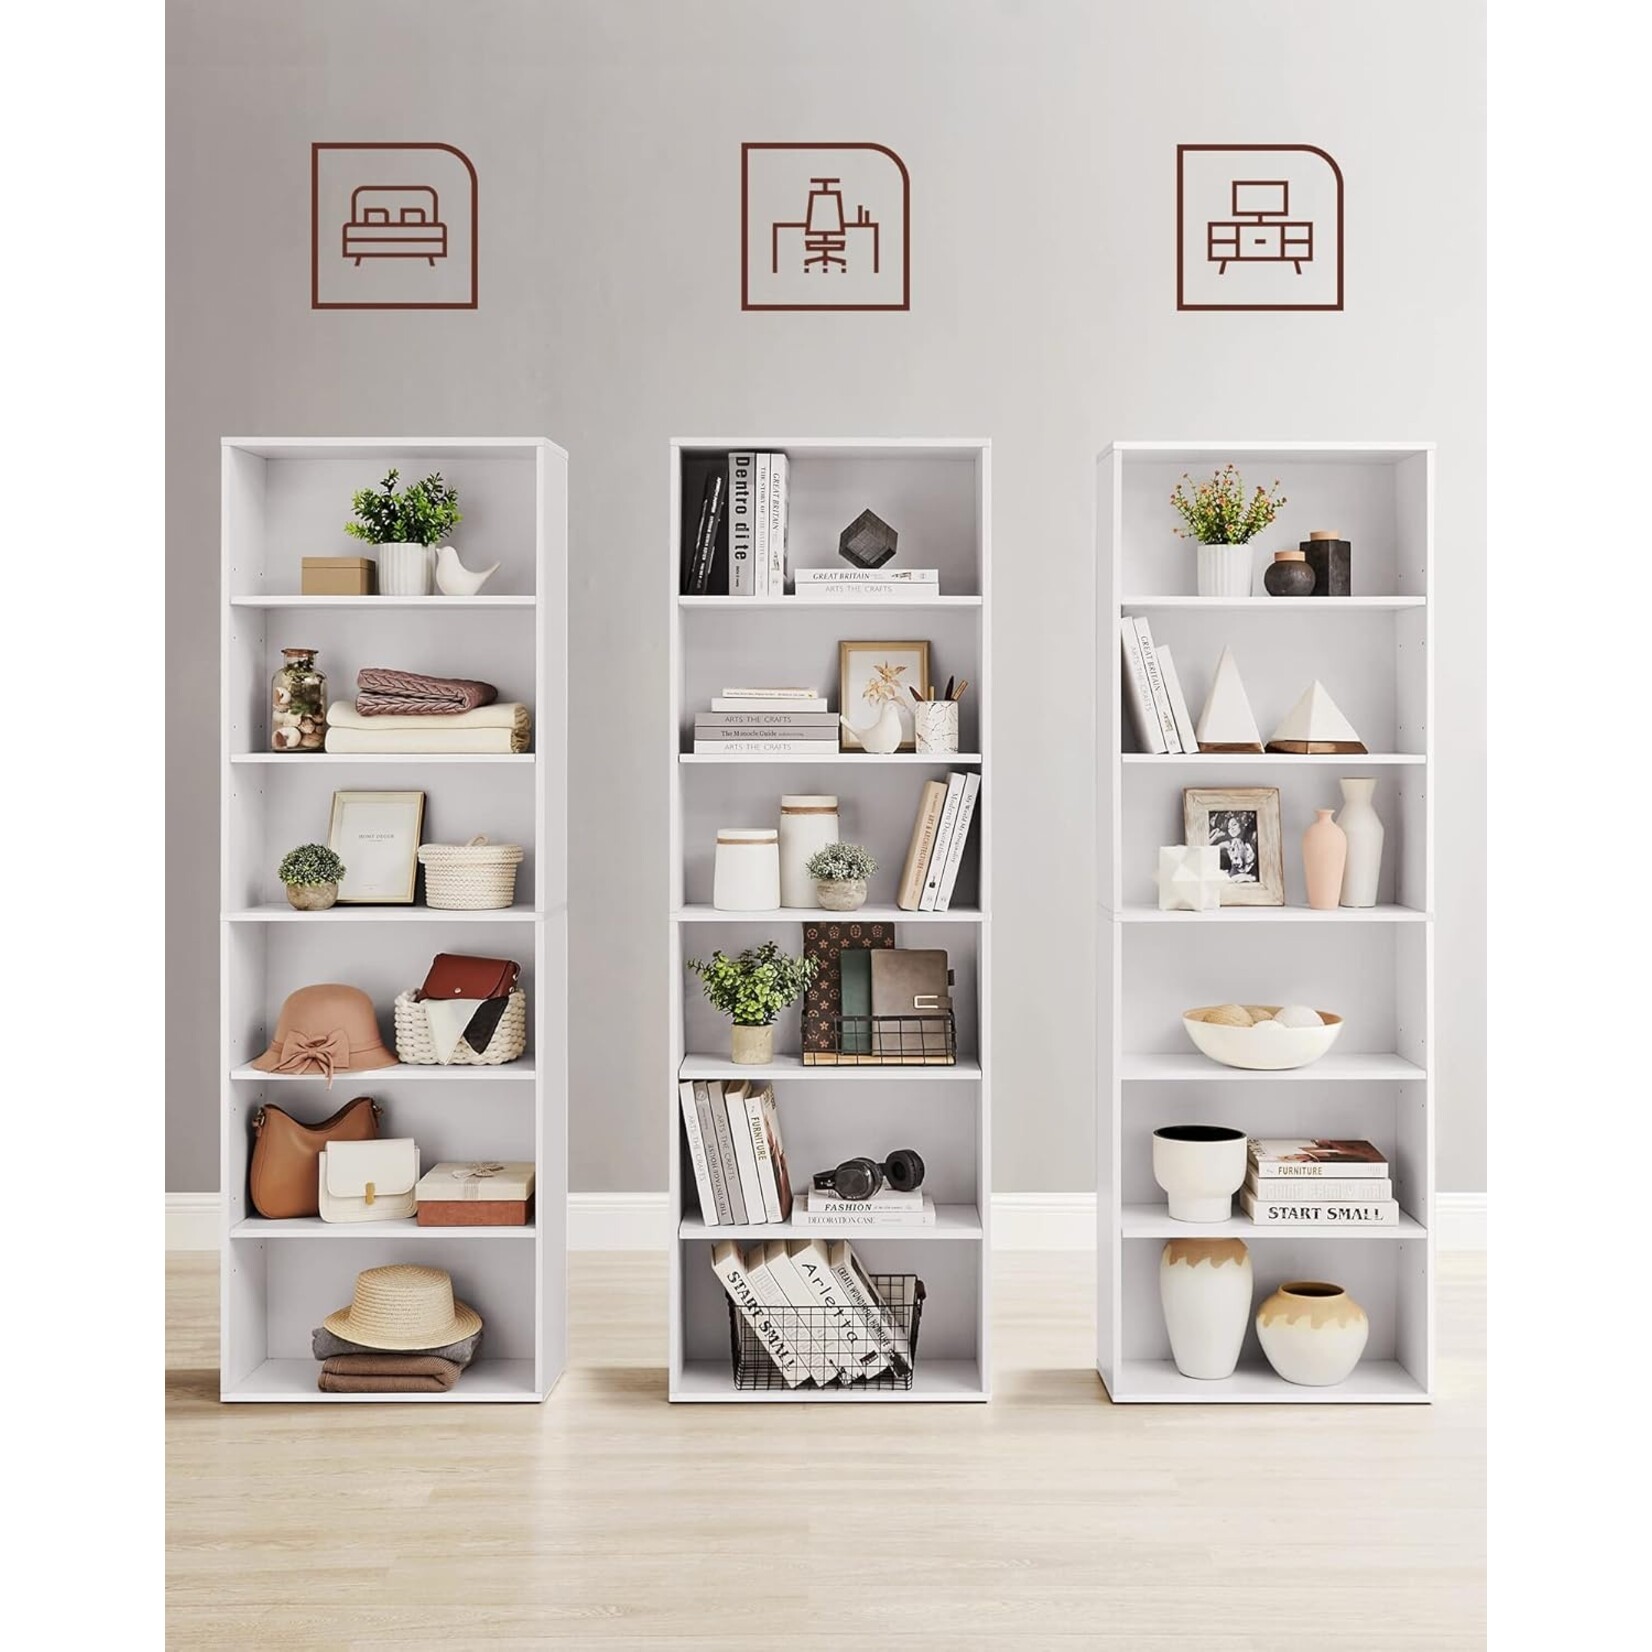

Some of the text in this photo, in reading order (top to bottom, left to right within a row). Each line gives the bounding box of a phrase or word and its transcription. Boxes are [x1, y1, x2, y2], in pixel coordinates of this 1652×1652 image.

[735, 456, 750, 560] Dentro di te
[772, 472, 781, 531] GREAT BRITAIN
[812, 572, 838, 581] GREAT
[839, 572, 871, 581] BRITAIN
[825, 585, 894, 593] ARTS THE CRAFTS
[1140, 635, 1161, 692] GREAT BRITAIN
[724, 716, 792, 724] ARTS THE CRAFTS
[724, 743, 792, 751] ARTS THE CRAFTS
[935, 792, 958, 862] Modern Decoration
[715, 1113, 736, 1181] ARTS THE CRAFTS
[750, 1116, 768, 1161] FURNITURE
[1277, 1166, 1323, 1176] FURNITURE
[719, 1199, 728, 1217] THE
[824, 1203, 873, 1212] FASHION
[1267, 1206, 1384, 1221] START SMALL
[807, 1216, 857, 1225] DECORATION
[837, 1266, 855, 1289] CREATE
[801, 1262, 860, 1345] Arletta
[726, 1270, 763, 1319] START
[758, 1319, 799, 1373] SMALL
